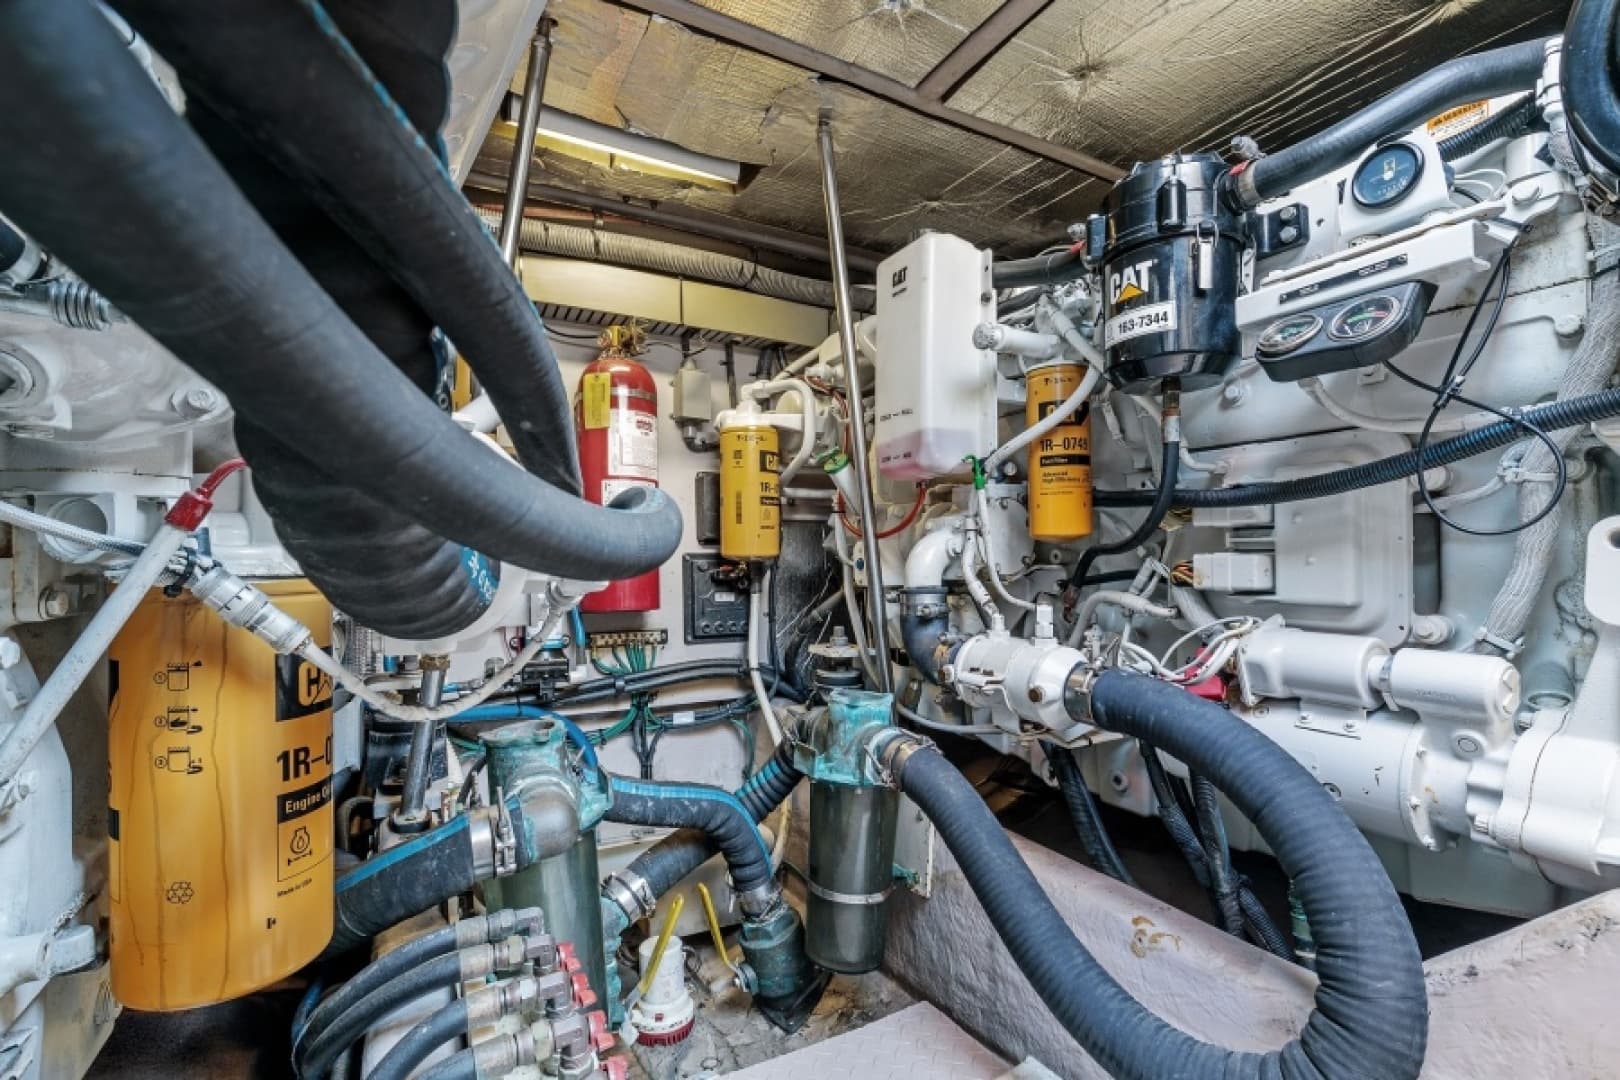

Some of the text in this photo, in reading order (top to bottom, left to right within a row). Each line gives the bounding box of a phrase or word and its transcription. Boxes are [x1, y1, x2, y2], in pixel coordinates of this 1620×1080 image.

[892, 265, 908, 289] CAT
[1110, 260, 1153, 305] CAT
[286, 793, 321, 815] Engine
